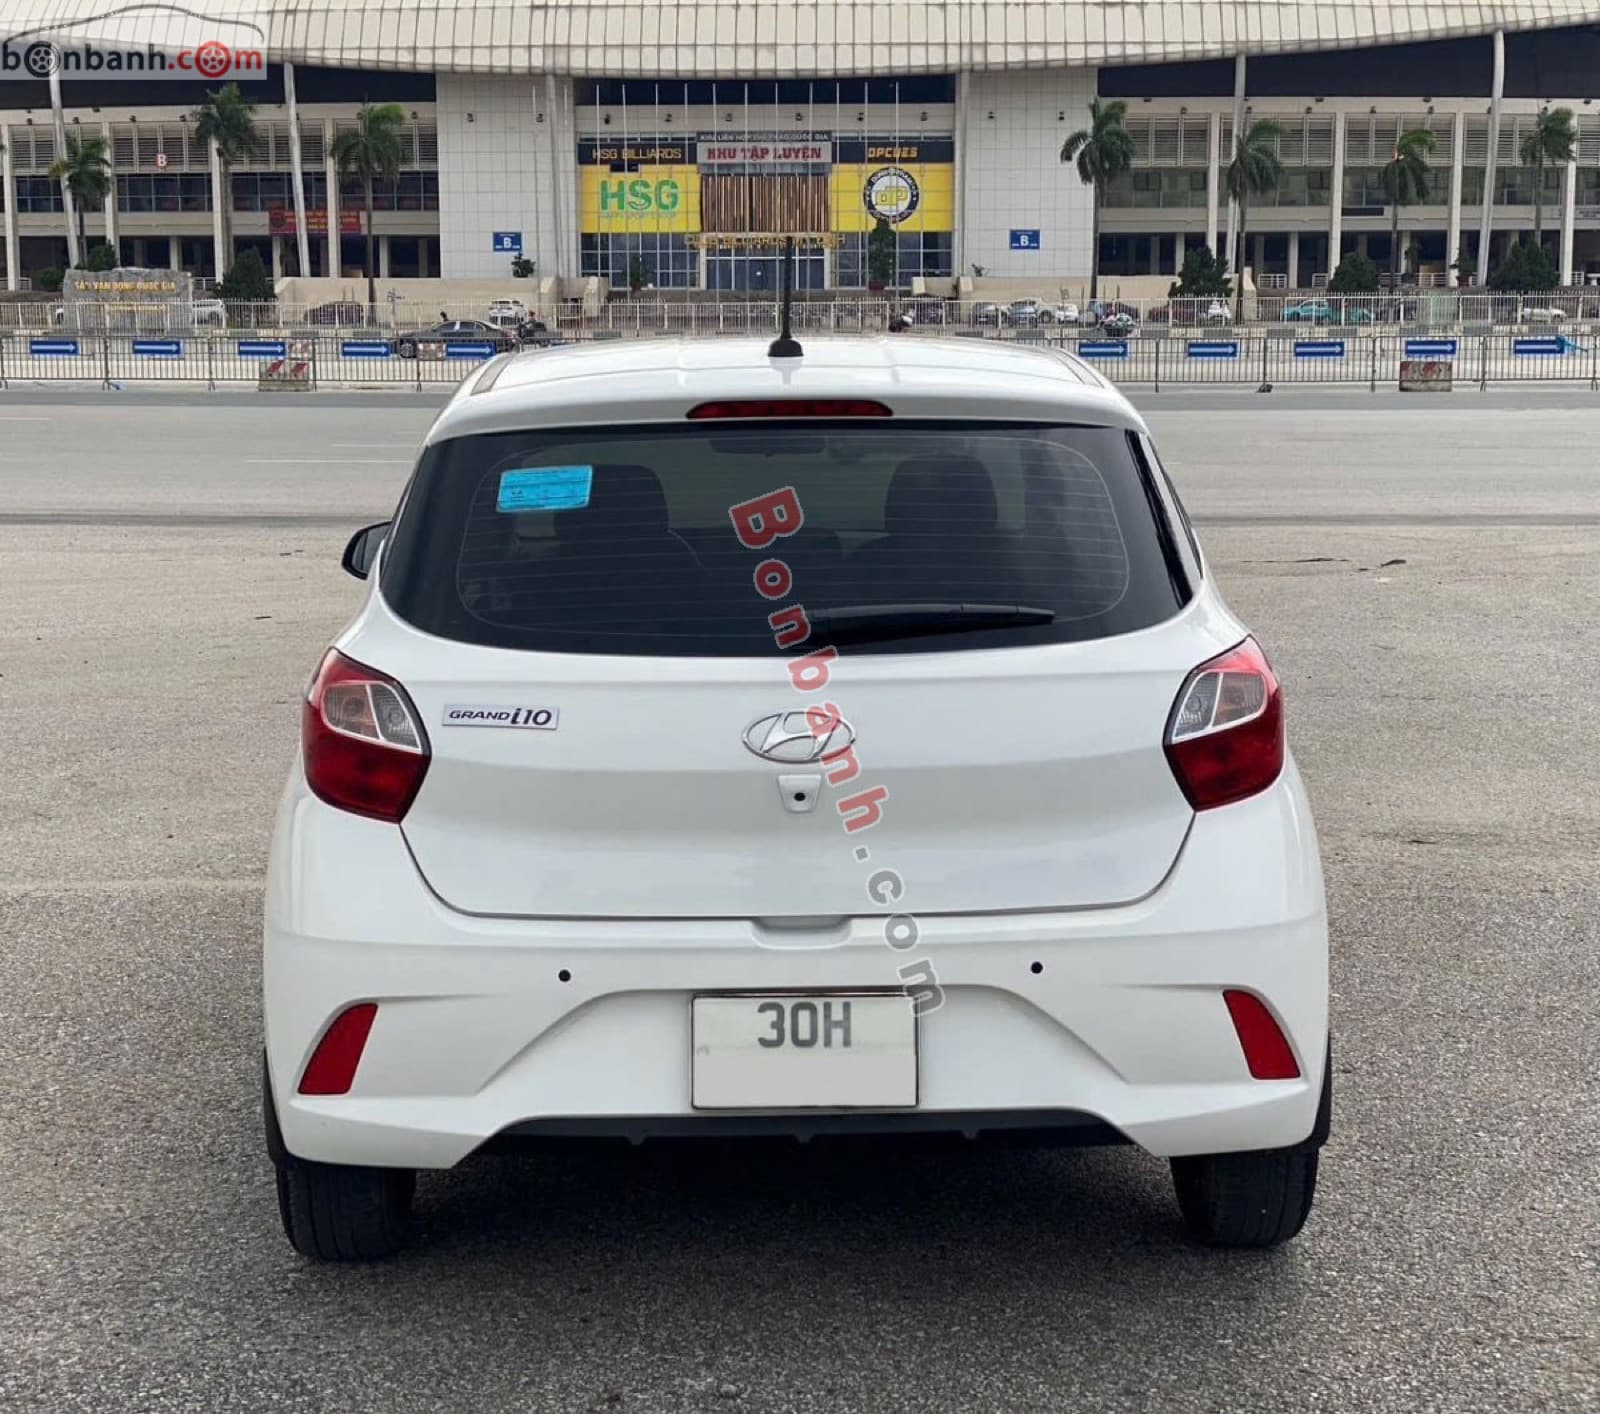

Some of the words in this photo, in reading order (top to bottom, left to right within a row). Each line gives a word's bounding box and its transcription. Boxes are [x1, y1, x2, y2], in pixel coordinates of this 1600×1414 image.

[593, 148, 618, 159] HSG
[622, 148, 682, 159] BILLIARDS
[707, 148, 737, 160] KHU
[740, 145, 769, 161] TẬP
[600, 179, 679, 211] HSG
[503, 237, 512, 249] B
[1020, 235, 1030, 247] B
[449, 710, 511, 721] GRAND
[757, 1001, 852, 1049] 30H
